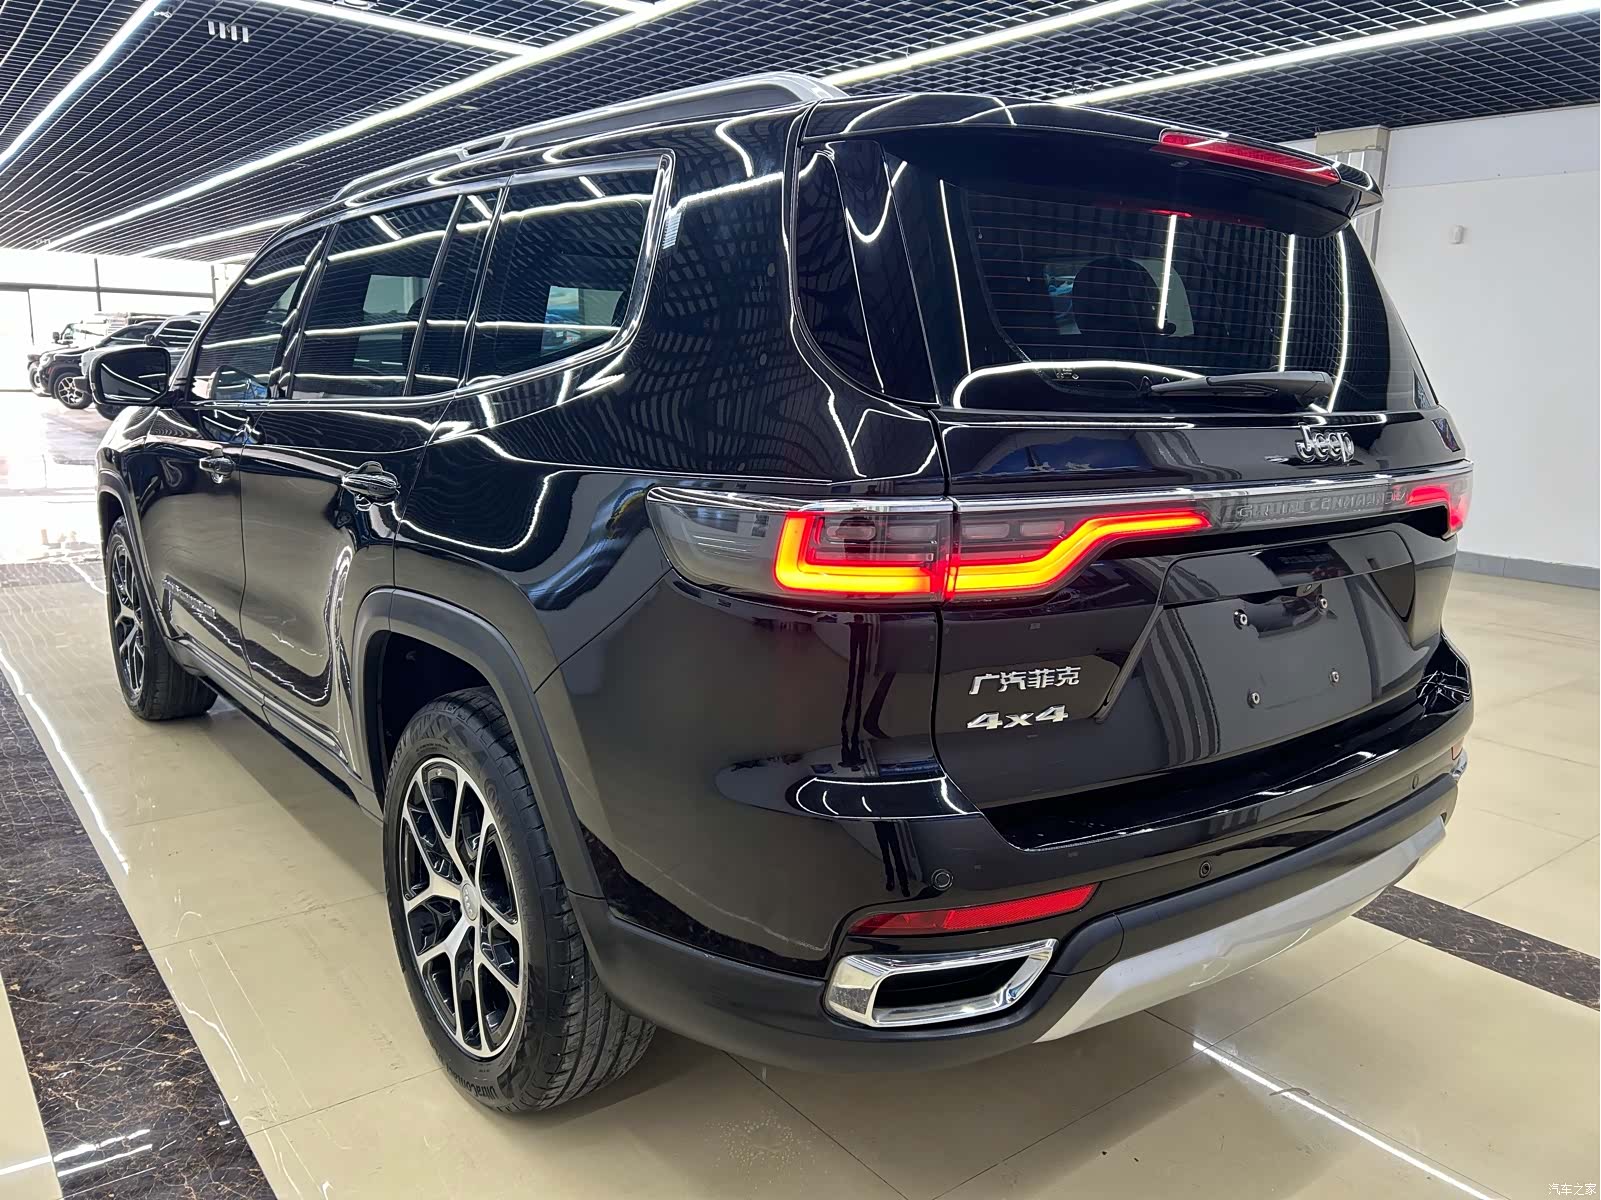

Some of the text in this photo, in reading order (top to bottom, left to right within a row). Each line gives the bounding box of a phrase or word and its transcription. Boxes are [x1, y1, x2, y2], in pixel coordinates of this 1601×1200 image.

[1295, 422, 1355, 463] Jeep
[968, 666, 1081, 695] 广汽菲克
[967, 705, 1069, 730] 4x4
